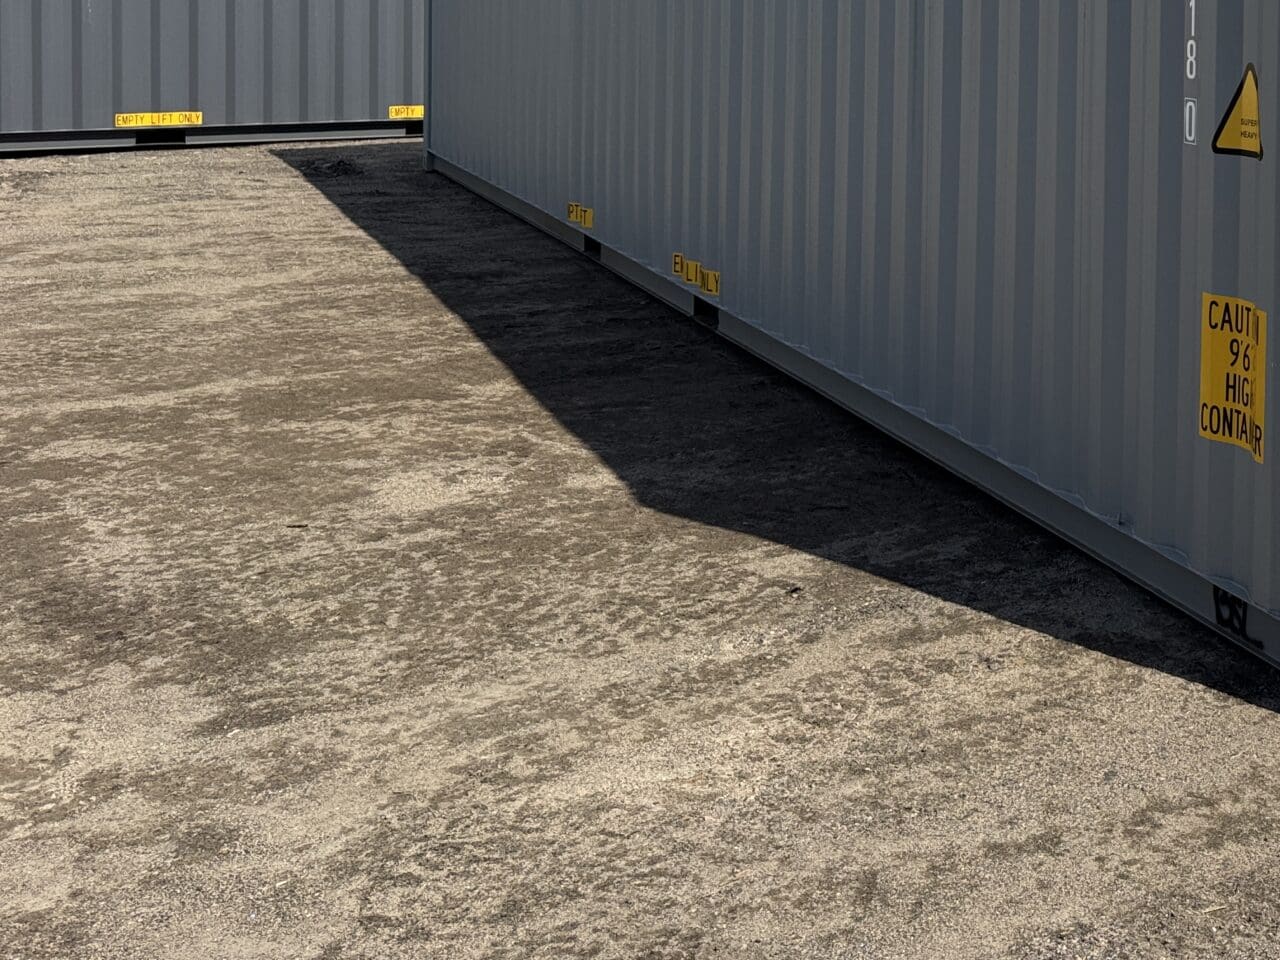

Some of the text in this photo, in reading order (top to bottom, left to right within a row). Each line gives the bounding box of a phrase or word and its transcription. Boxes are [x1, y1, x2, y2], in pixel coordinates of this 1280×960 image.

[116, 112, 200, 126] EMPTY LIFT ONLY
